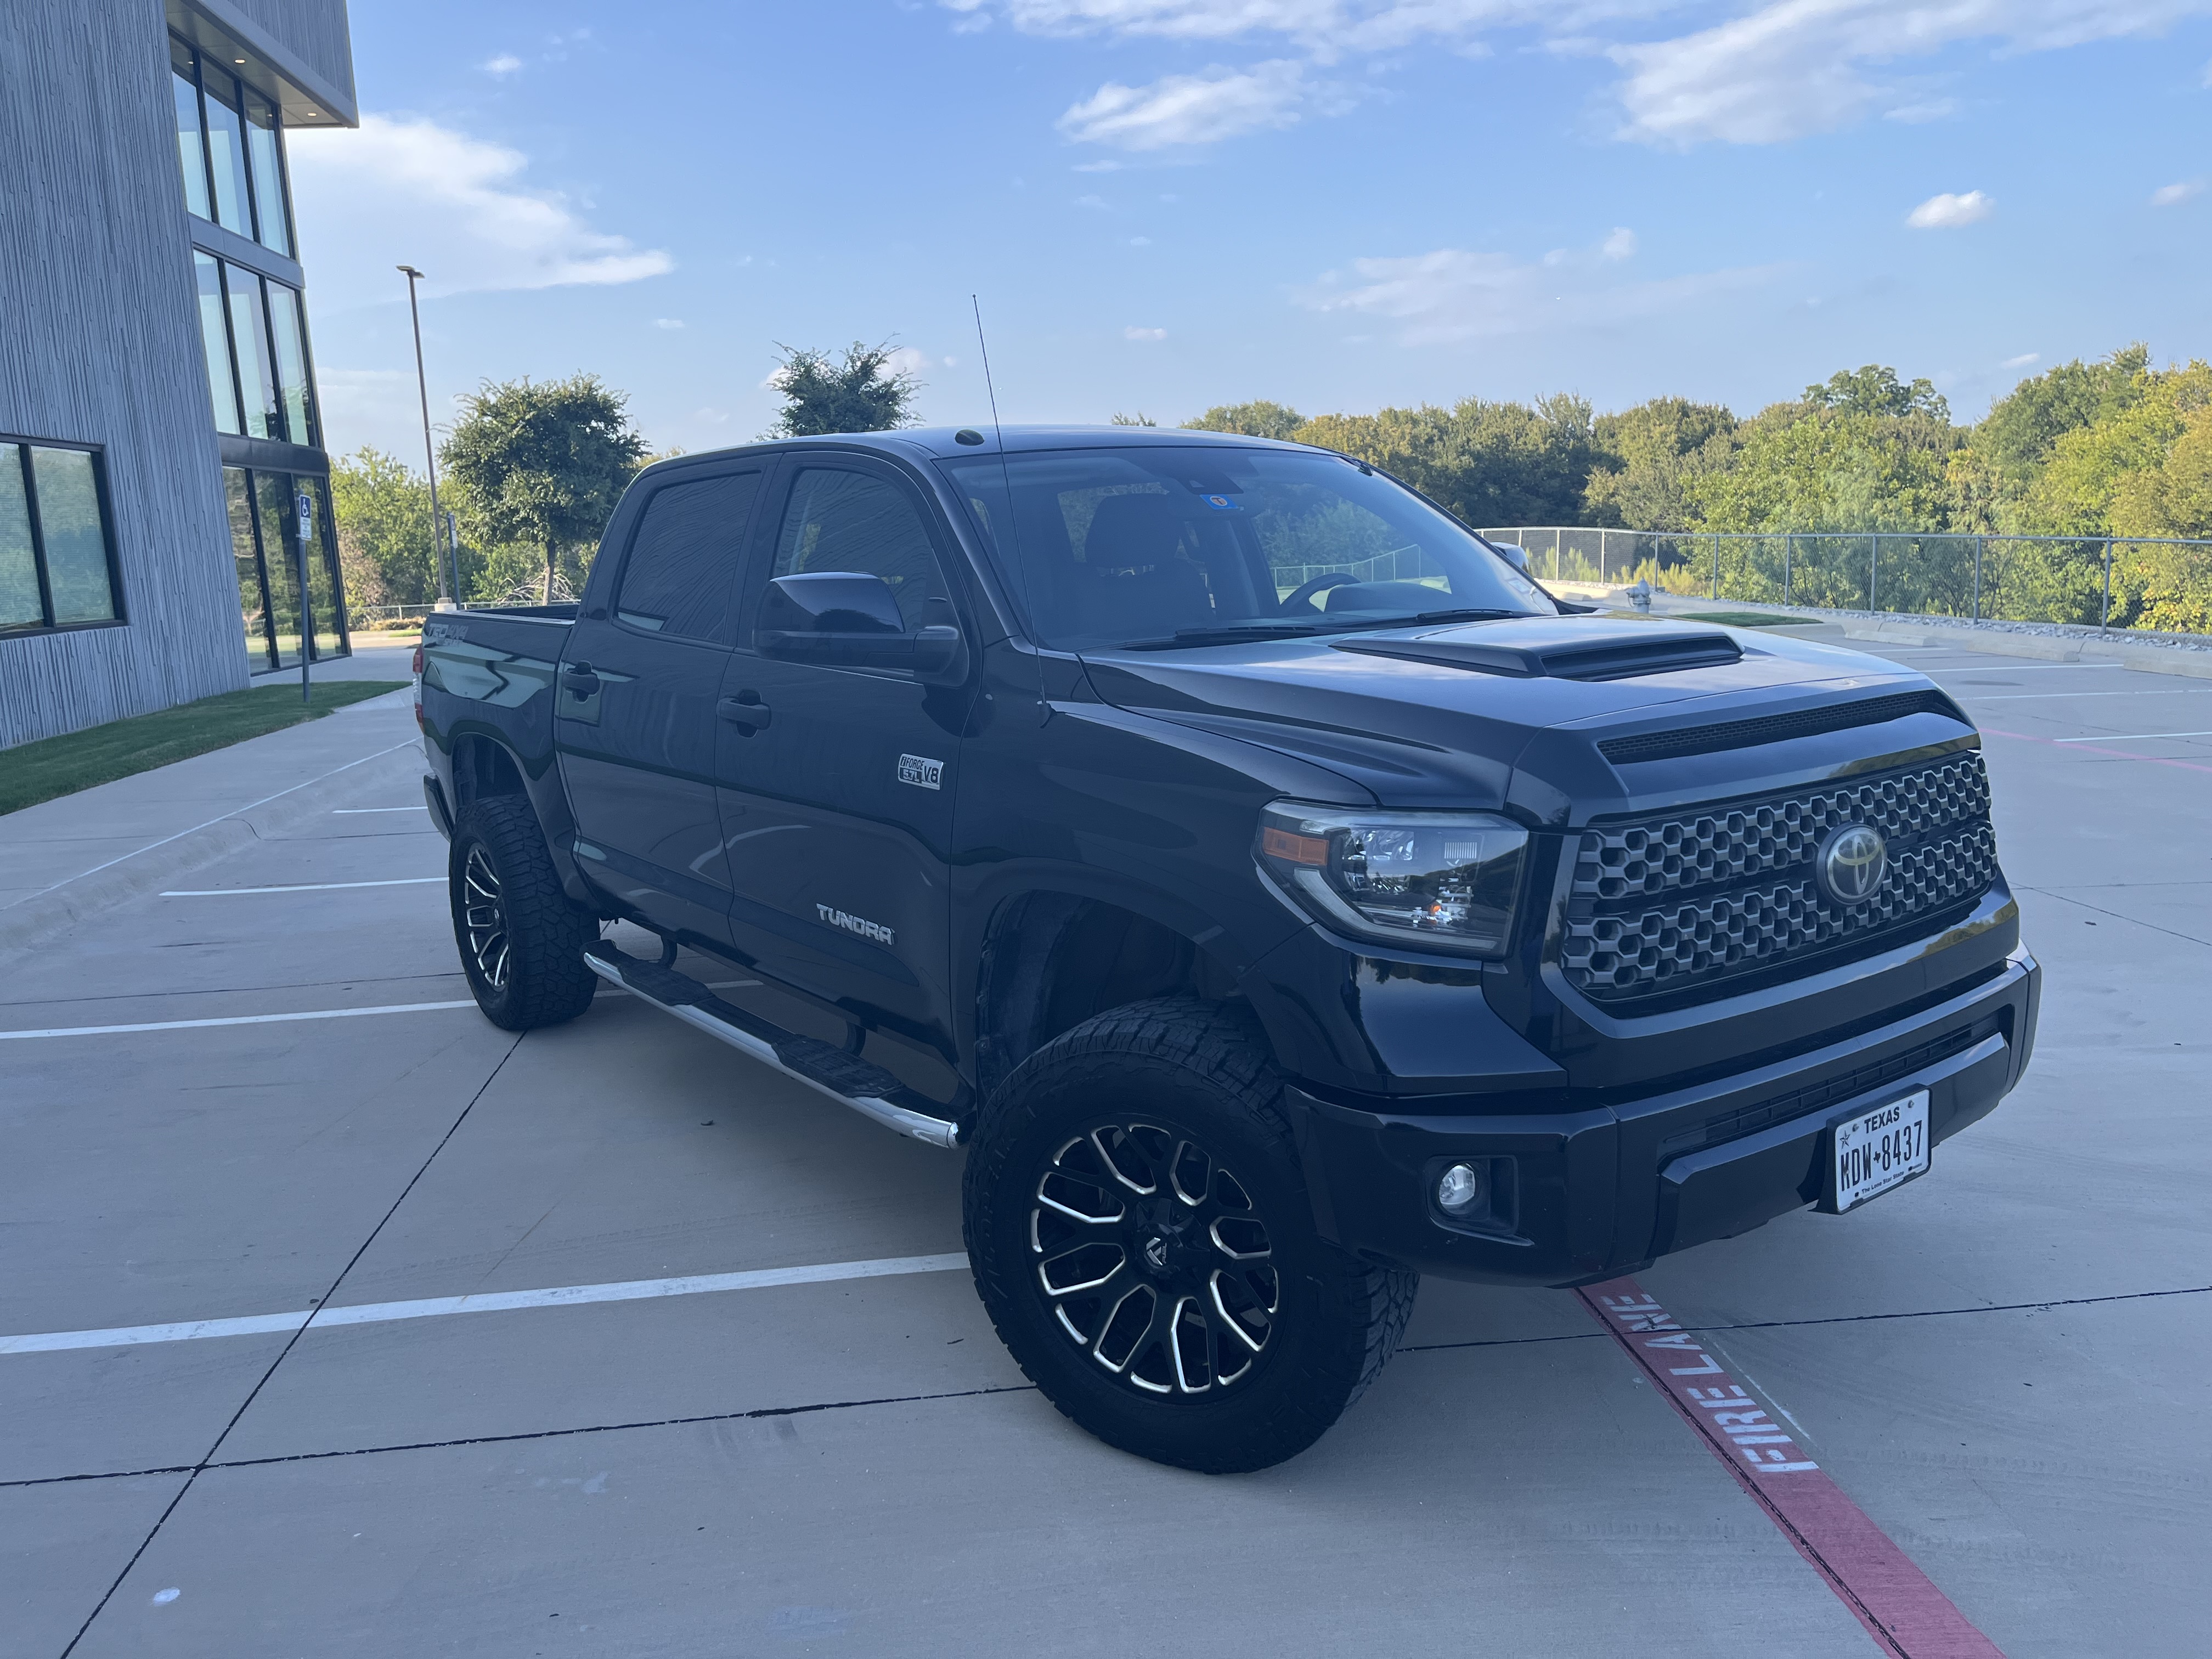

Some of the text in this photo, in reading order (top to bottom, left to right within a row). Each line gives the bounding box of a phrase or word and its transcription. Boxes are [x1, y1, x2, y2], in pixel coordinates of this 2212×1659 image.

[924, 766, 939, 783] V8
[816, 903, 895, 945] TUNDRA
[1864, 1106, 1900, 1134] TEXAS
[1871, 1182, 1882, 1190] Lone
[1893, 1171, 1904, 1180] State
[1599, 1293, 1820, 1473] FIRE LANE
